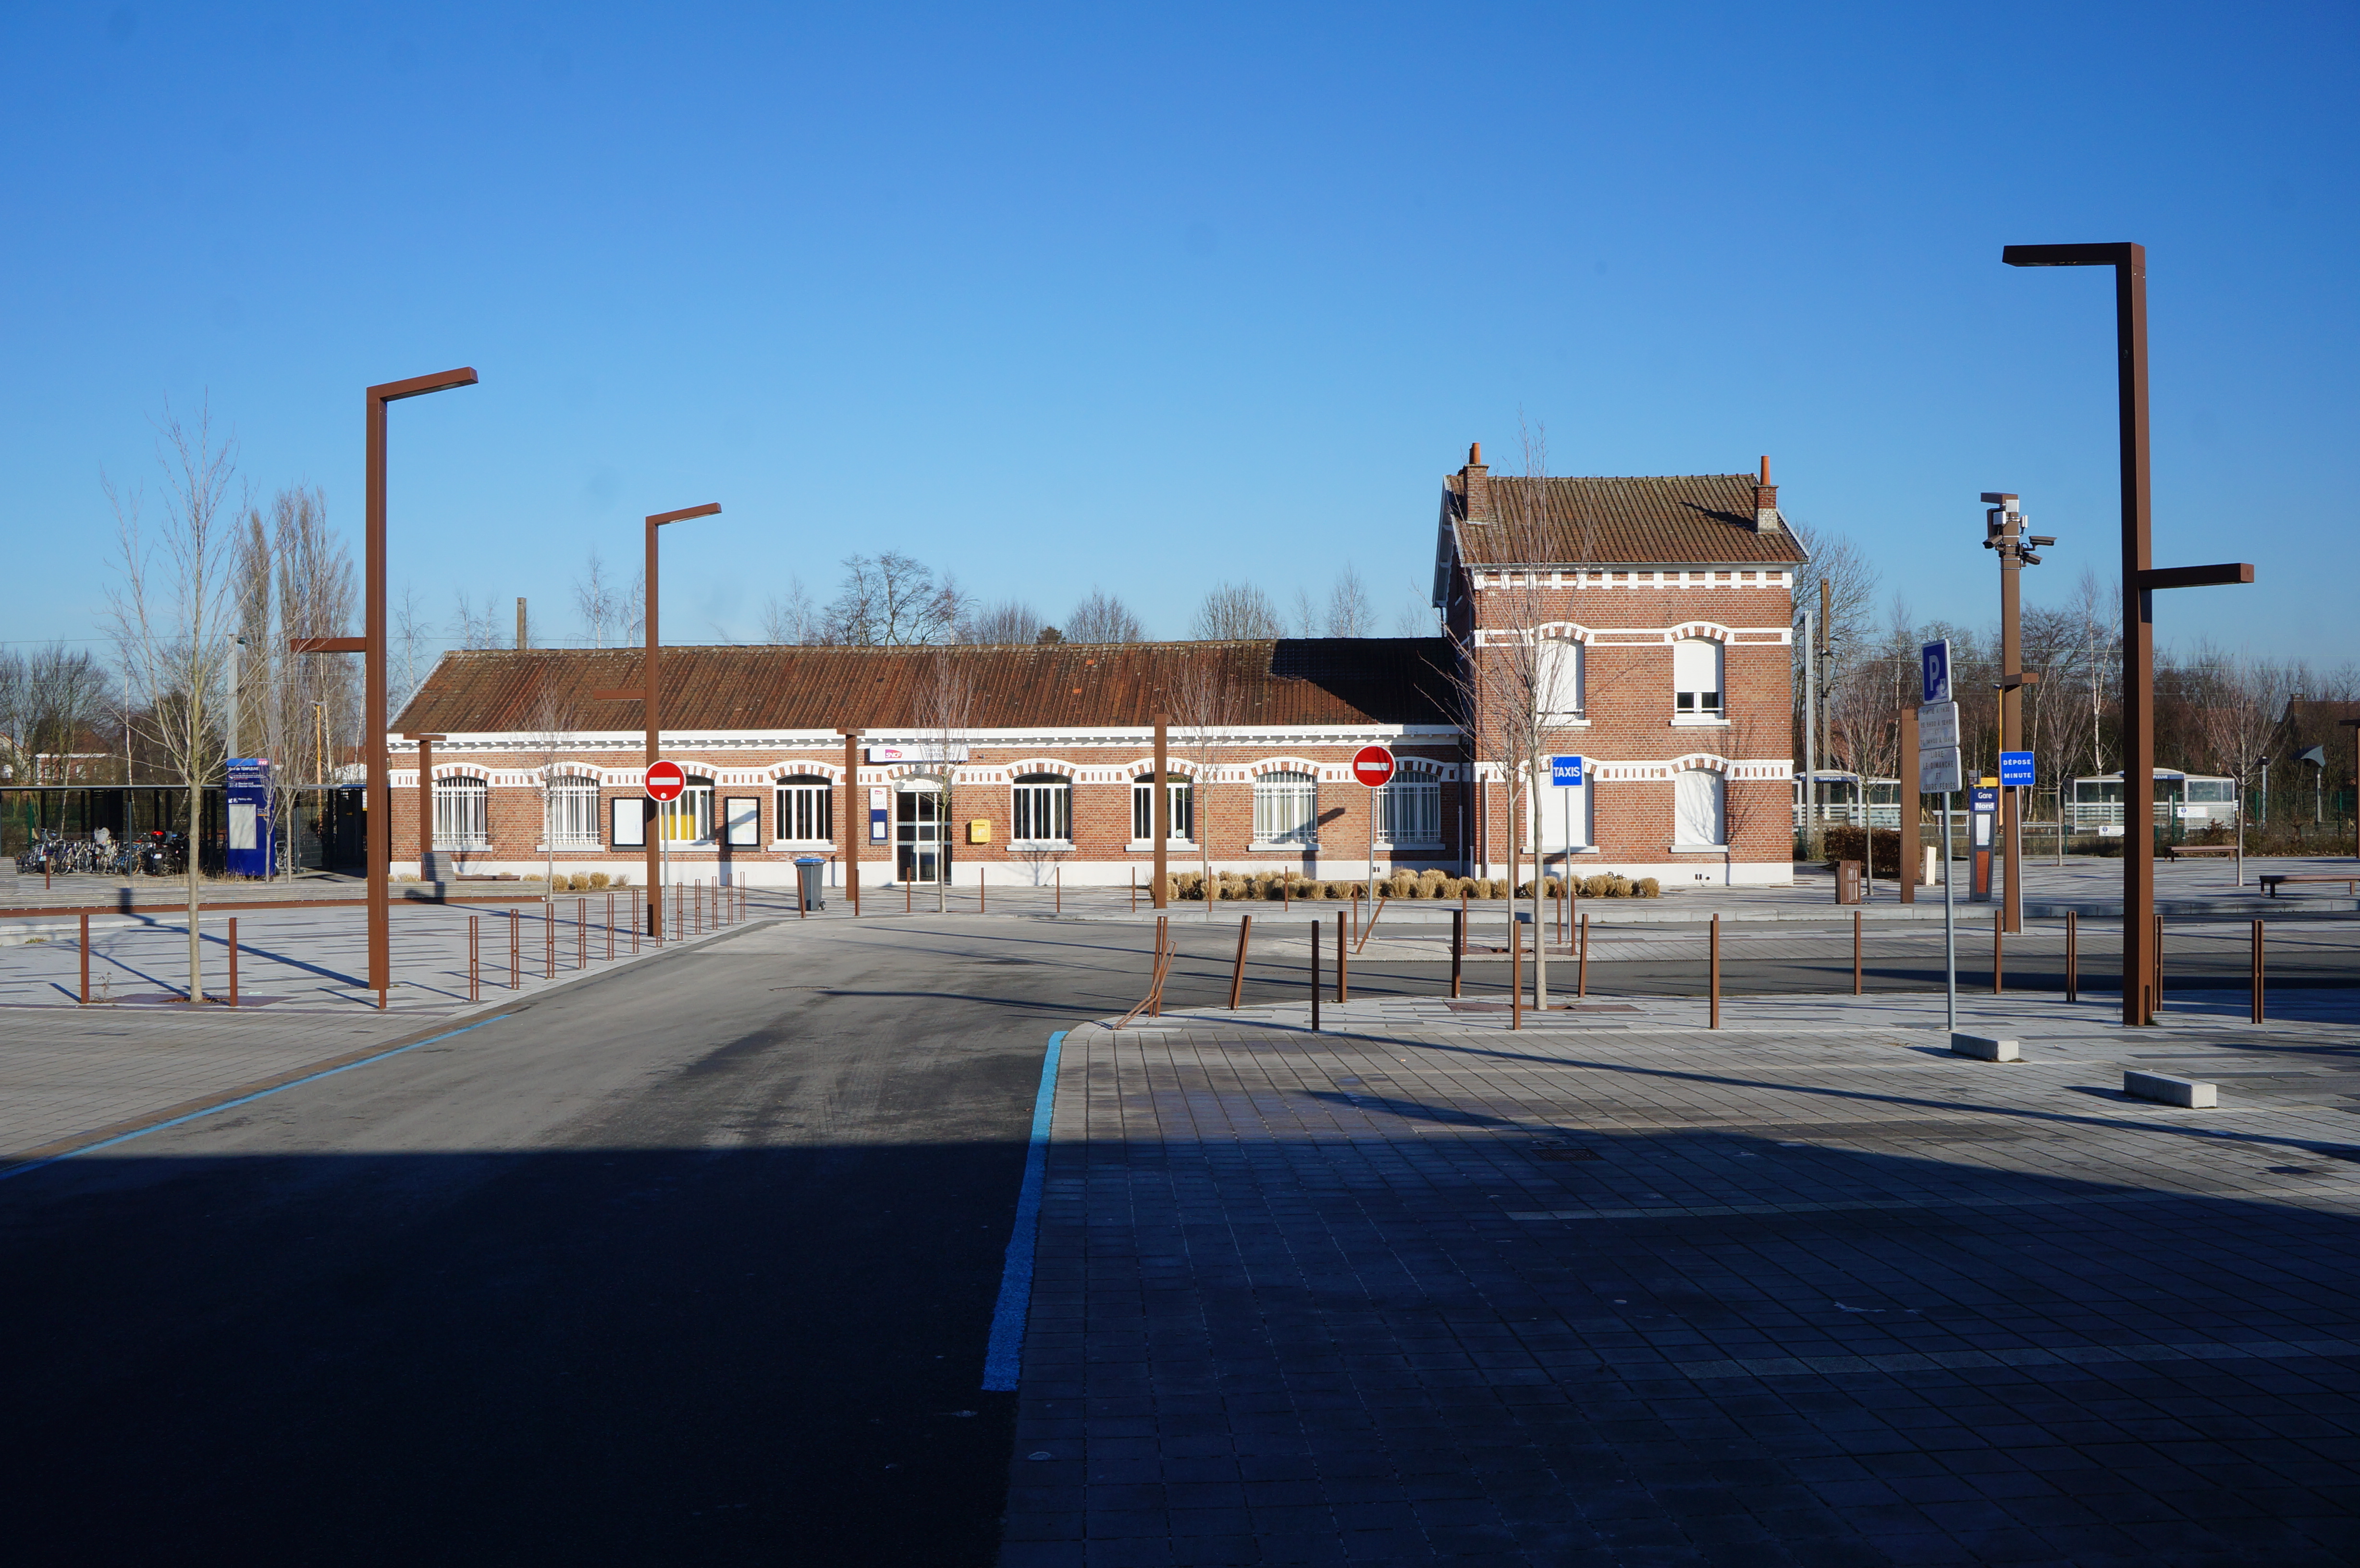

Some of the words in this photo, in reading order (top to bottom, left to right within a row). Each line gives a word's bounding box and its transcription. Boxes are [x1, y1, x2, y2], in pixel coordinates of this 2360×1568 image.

[1929, 654, 1940, 691] P
[1930, 760, 1954, 769] DIMANCHE
[1553, 766, 1580, 777] TAXIS
[1940, 781, 1956, 789] FÉRIÉS
